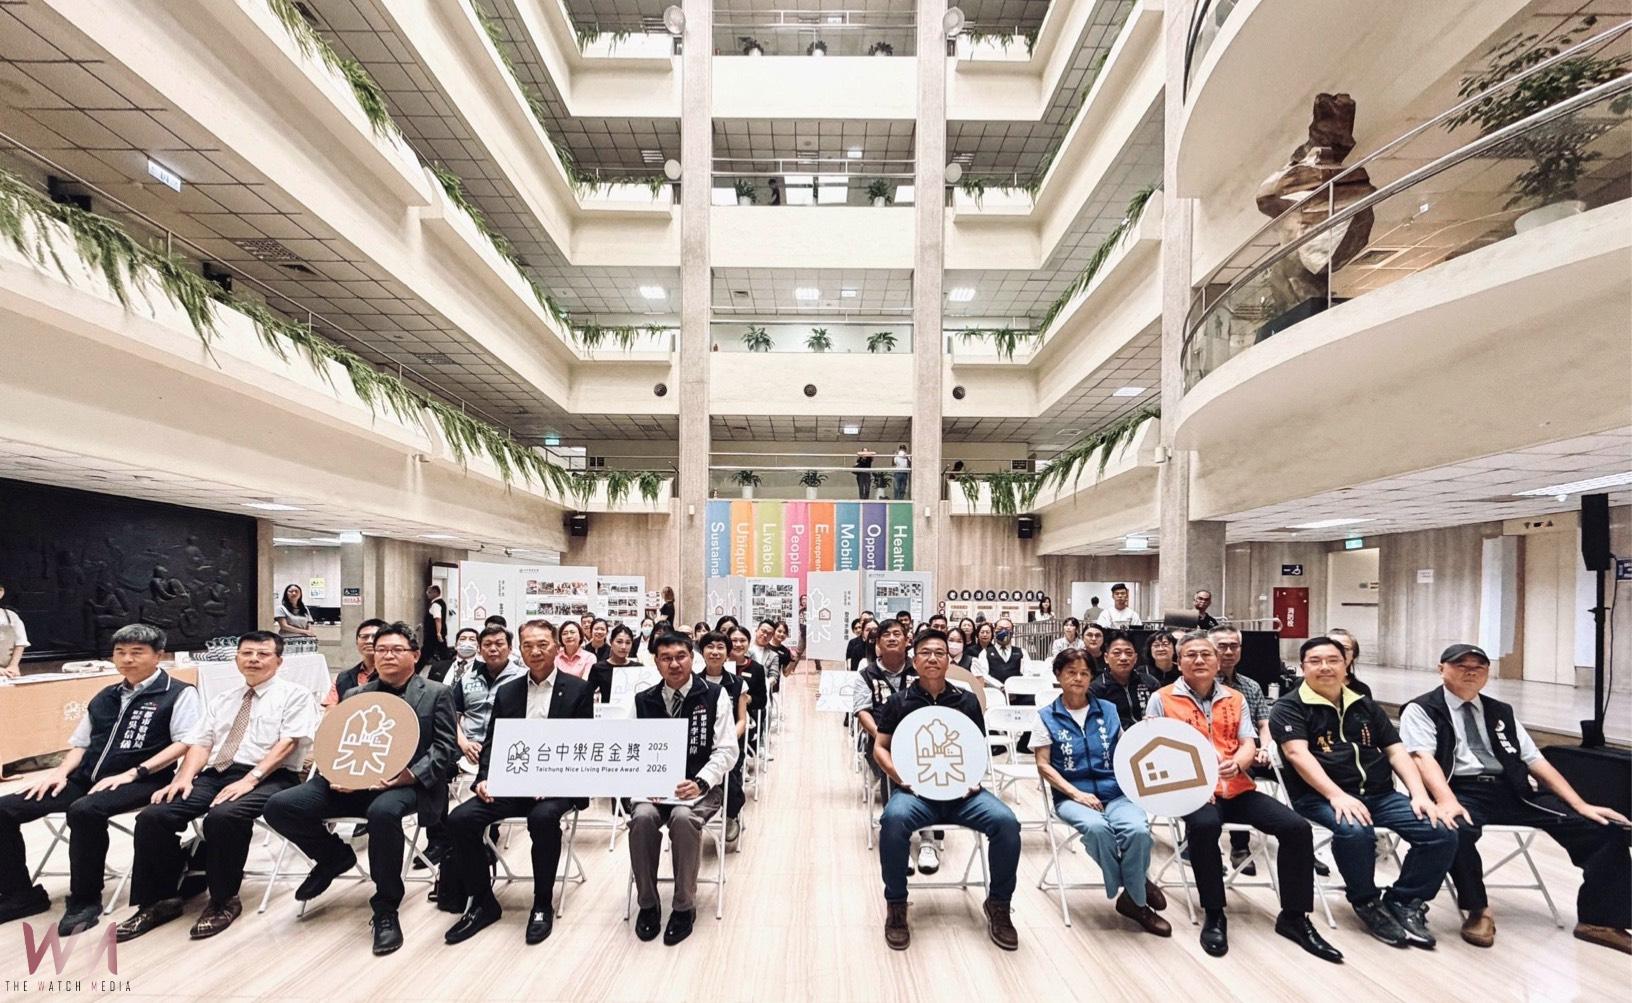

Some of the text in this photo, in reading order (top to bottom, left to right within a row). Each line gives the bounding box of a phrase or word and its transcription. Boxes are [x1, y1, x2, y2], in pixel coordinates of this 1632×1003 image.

[762, 523, 777, 573] Livable
[788, 524, 805, 573] People
[537, 742, 641, 762] 台中樂居金獎
[648, 743, 668, 751] 2025
[536, 766, 563, 774] Taichung
[581, 766, 600, 774] Living
[646, 764, 667, 773] 2026
